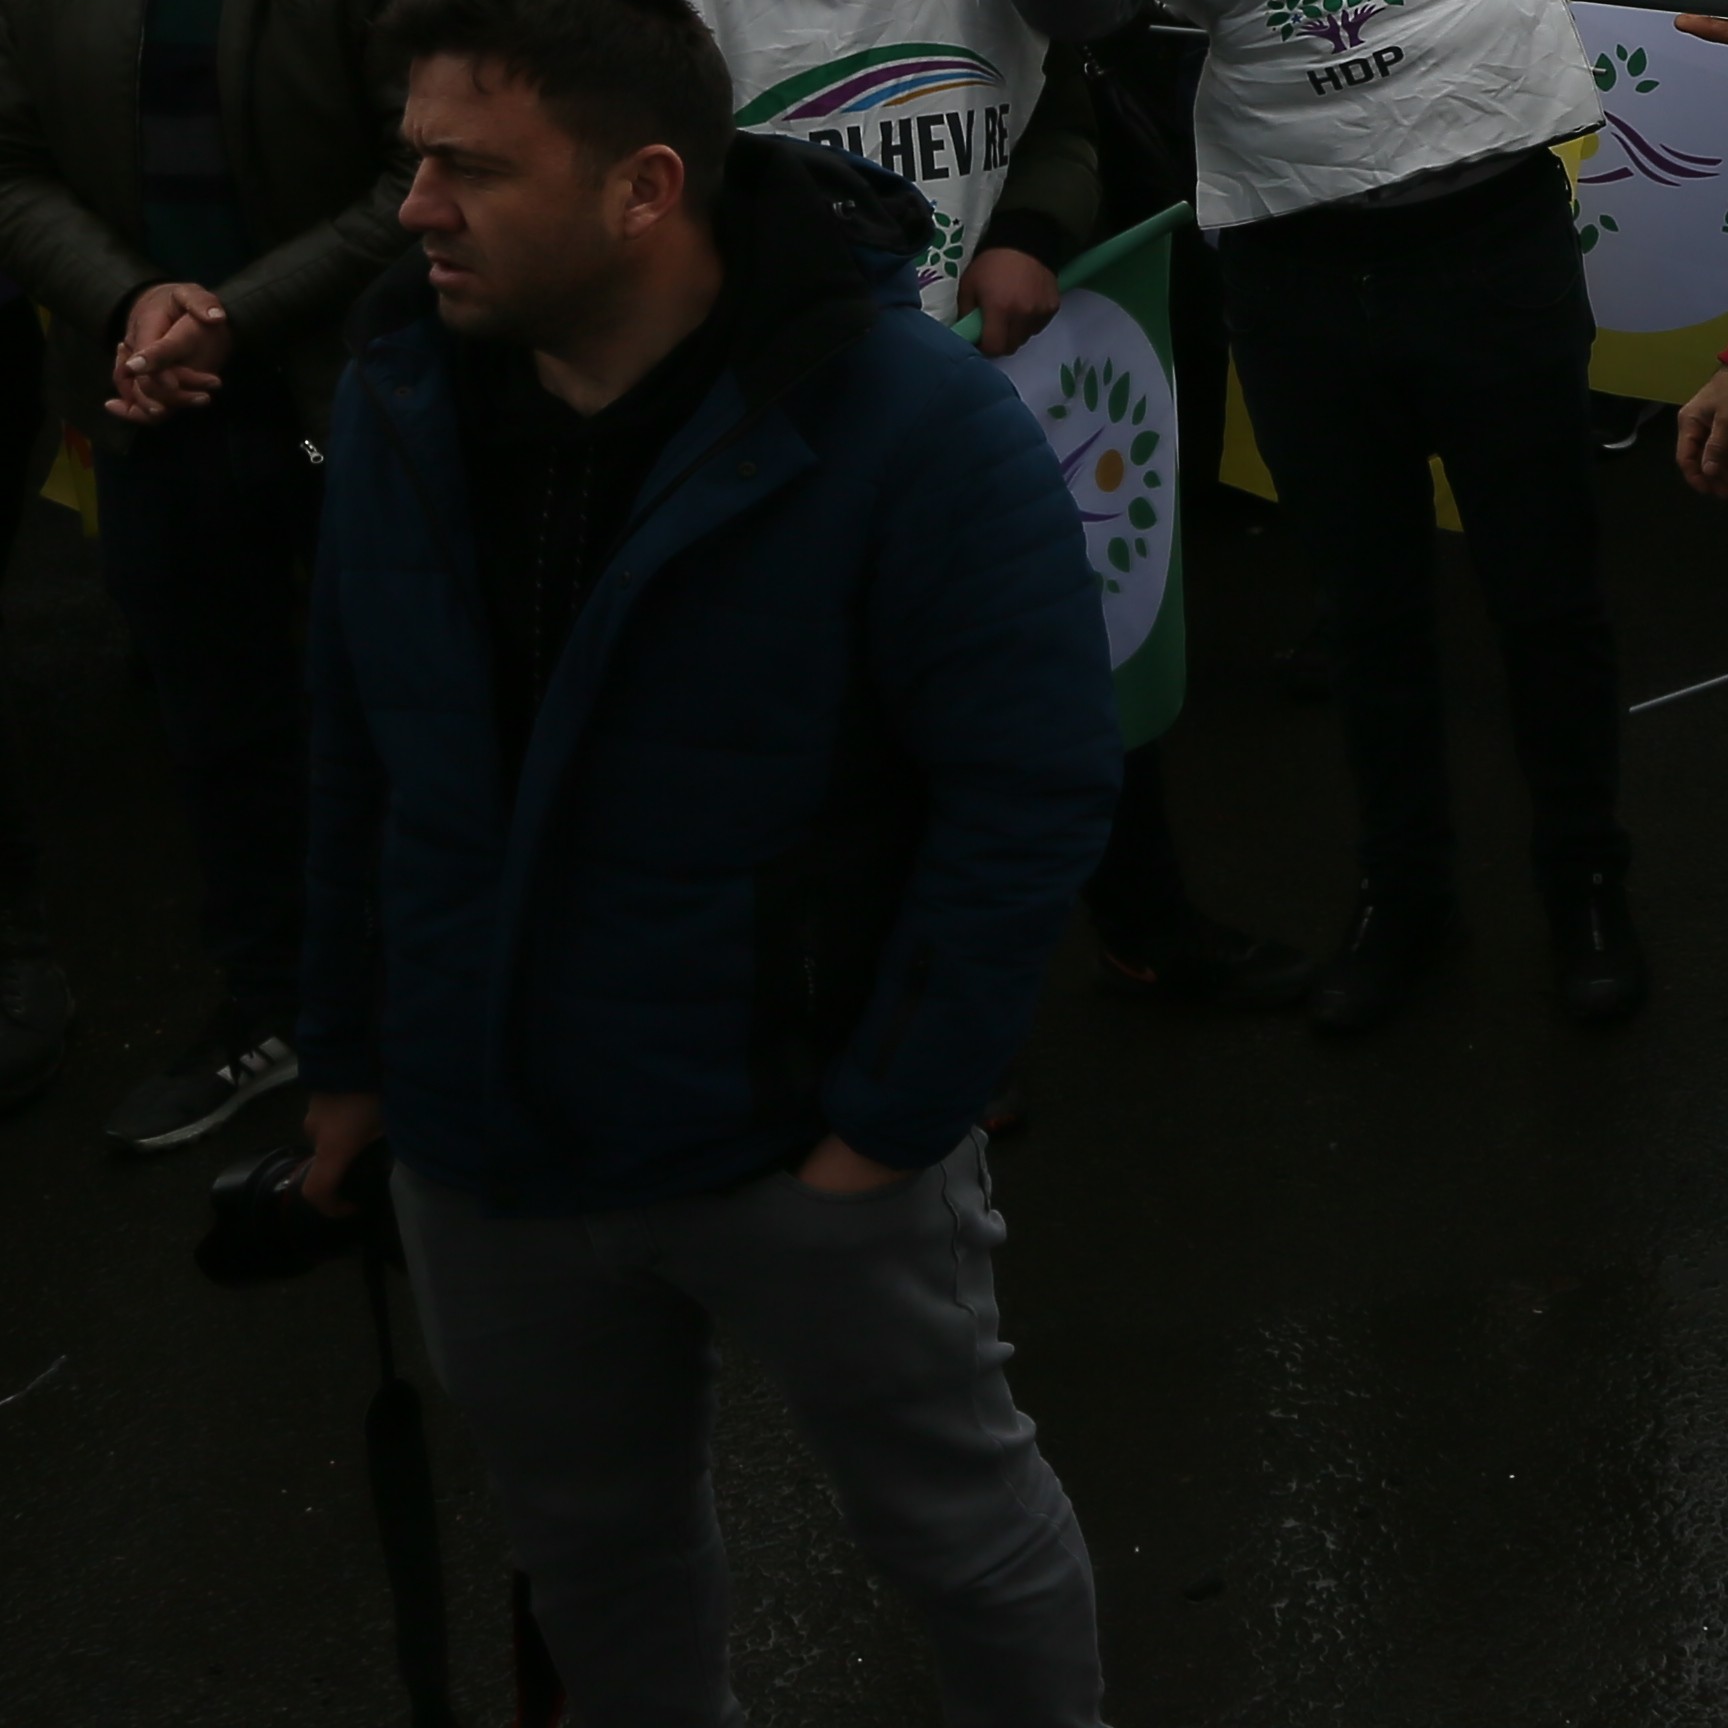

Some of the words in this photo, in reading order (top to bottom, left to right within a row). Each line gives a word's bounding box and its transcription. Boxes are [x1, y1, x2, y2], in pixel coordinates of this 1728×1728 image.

[1307, 45, 1405, 96] HDP
[880, 110, 975, 181] HEV
[983, 103, 1010, 172] RE
